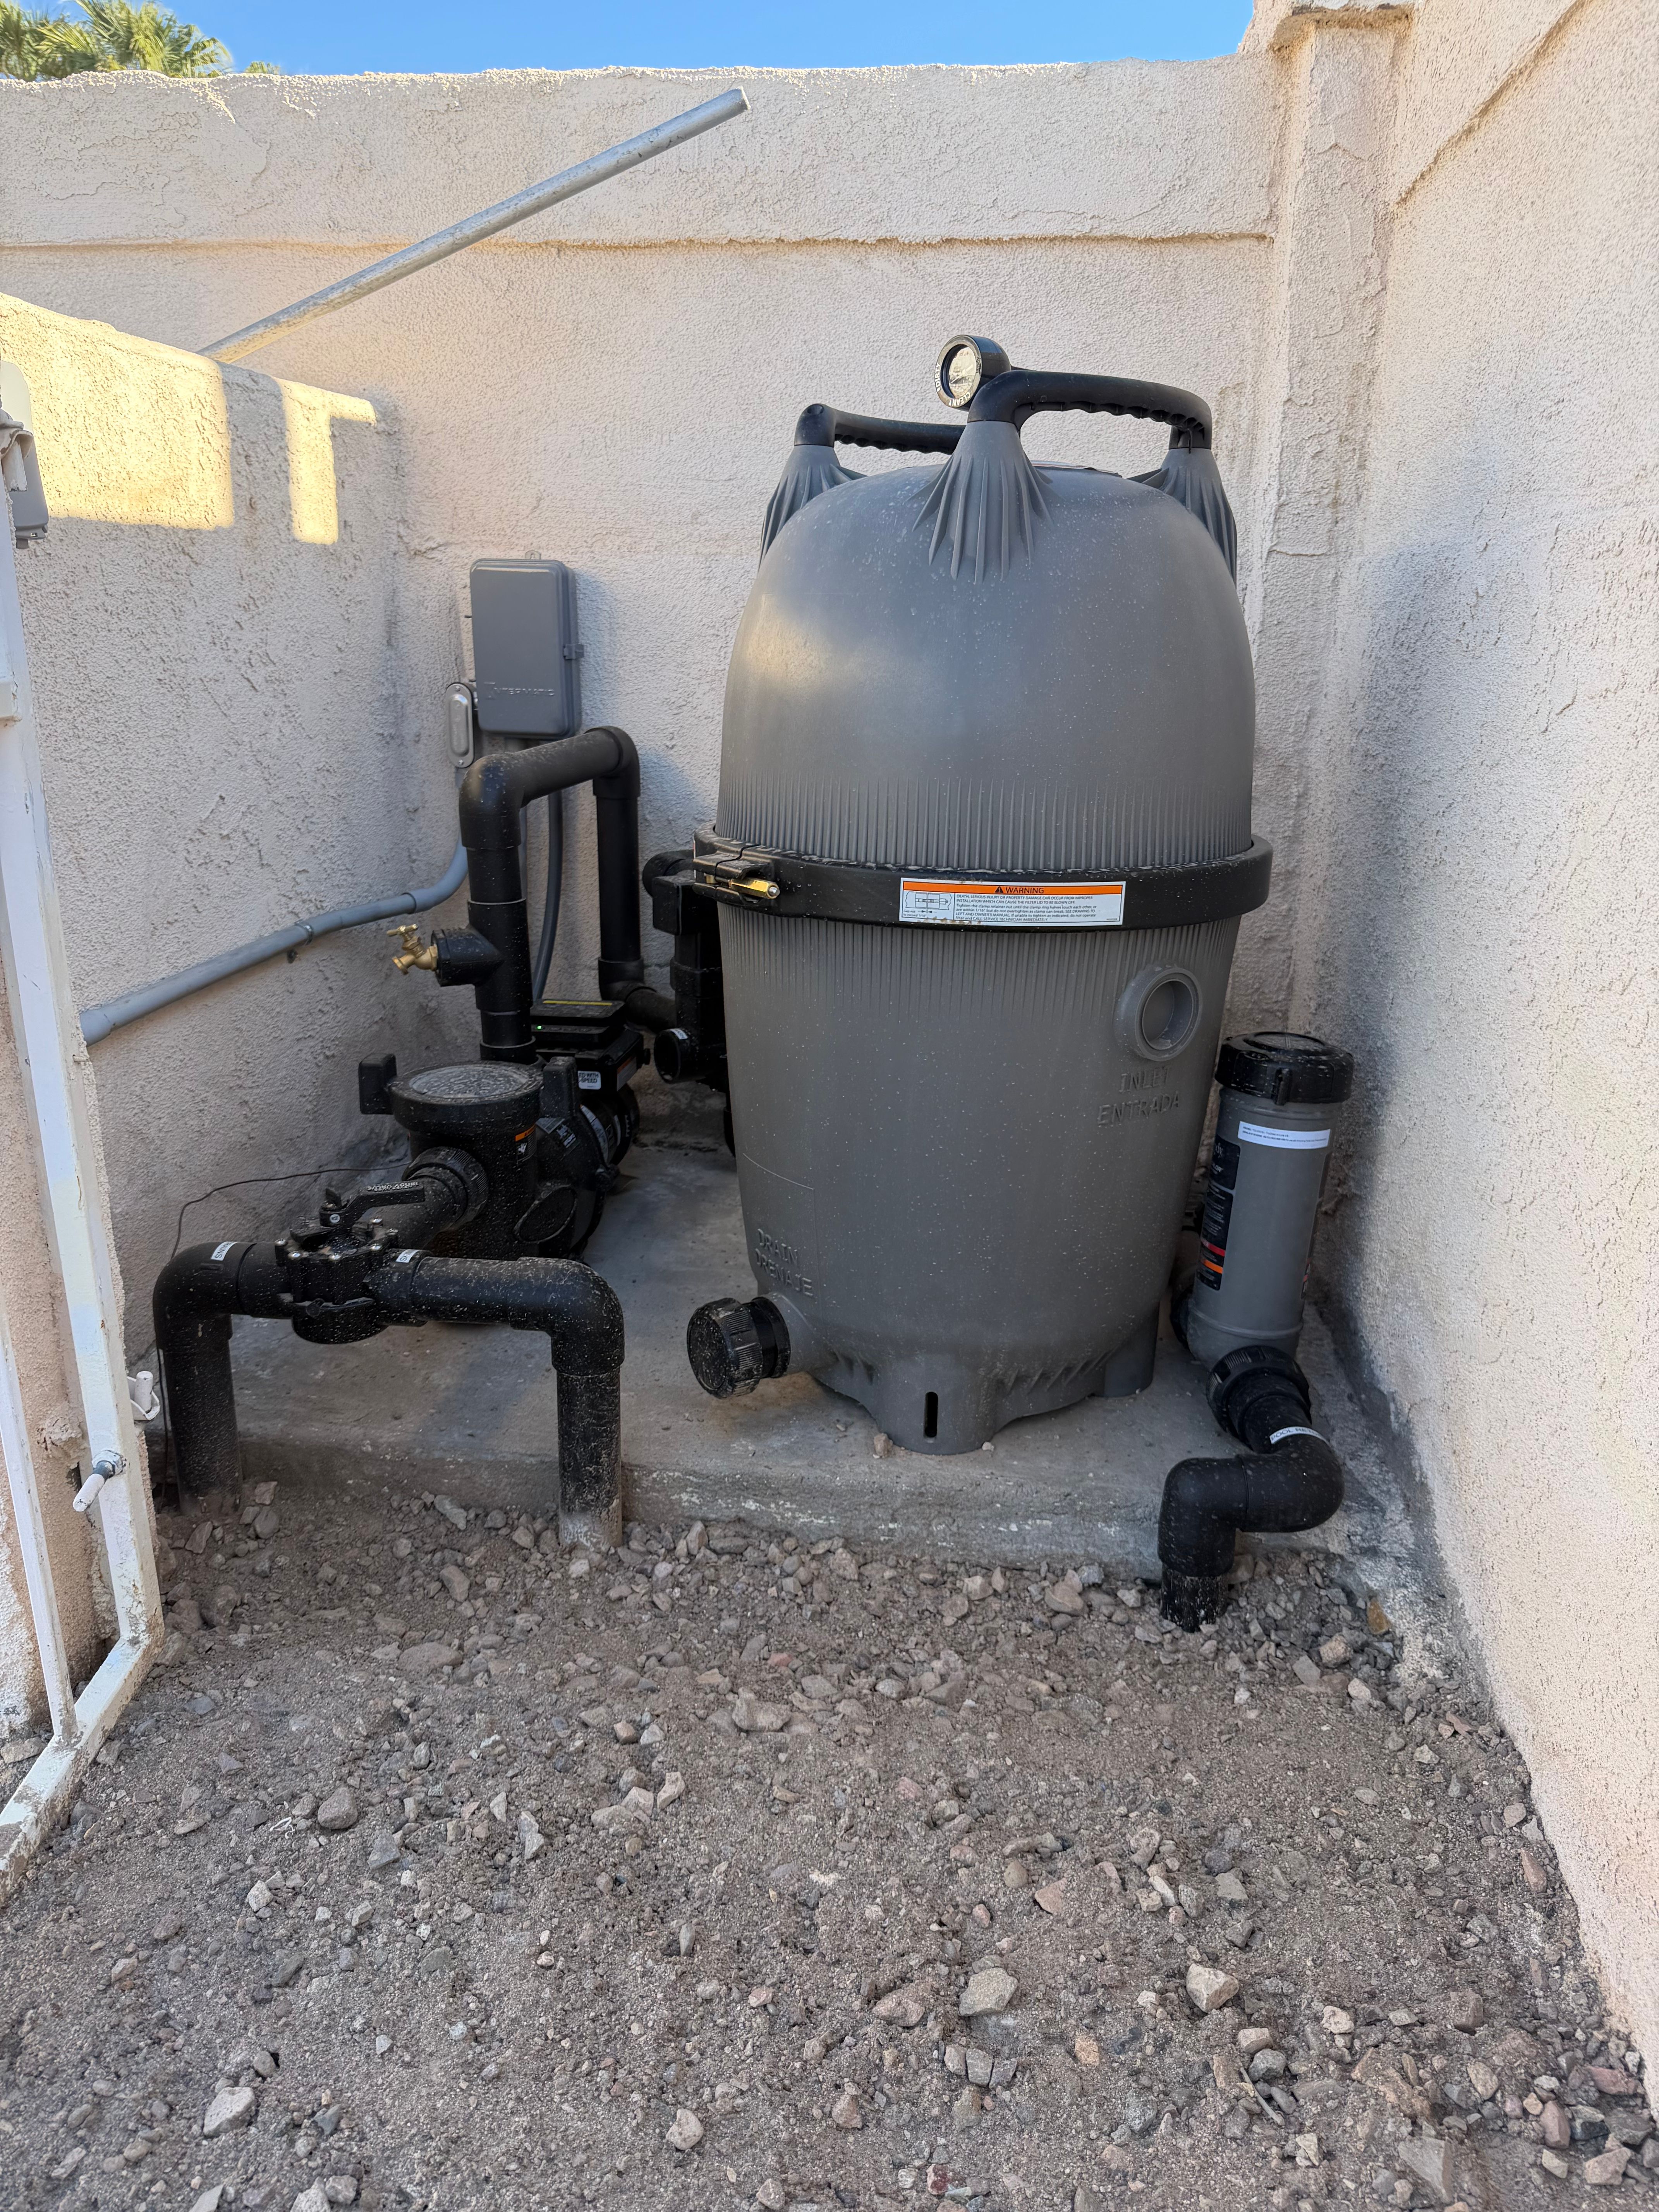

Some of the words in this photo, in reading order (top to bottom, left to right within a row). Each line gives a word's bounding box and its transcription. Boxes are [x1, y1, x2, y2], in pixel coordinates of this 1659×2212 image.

[952, 392, 971, 407] CLEAN
[484, 682, 555, 699] INTERMATIC
[1119, 1066, 1170, 1093] INLET
[1097, 1091, 1178, 1124] ENTRADA
[757, 1228, 799, 1266] DRAIN
[756, 1248, 813, 1296] DRENAJE
[1271, 1429, 1293, 1441] POOL
